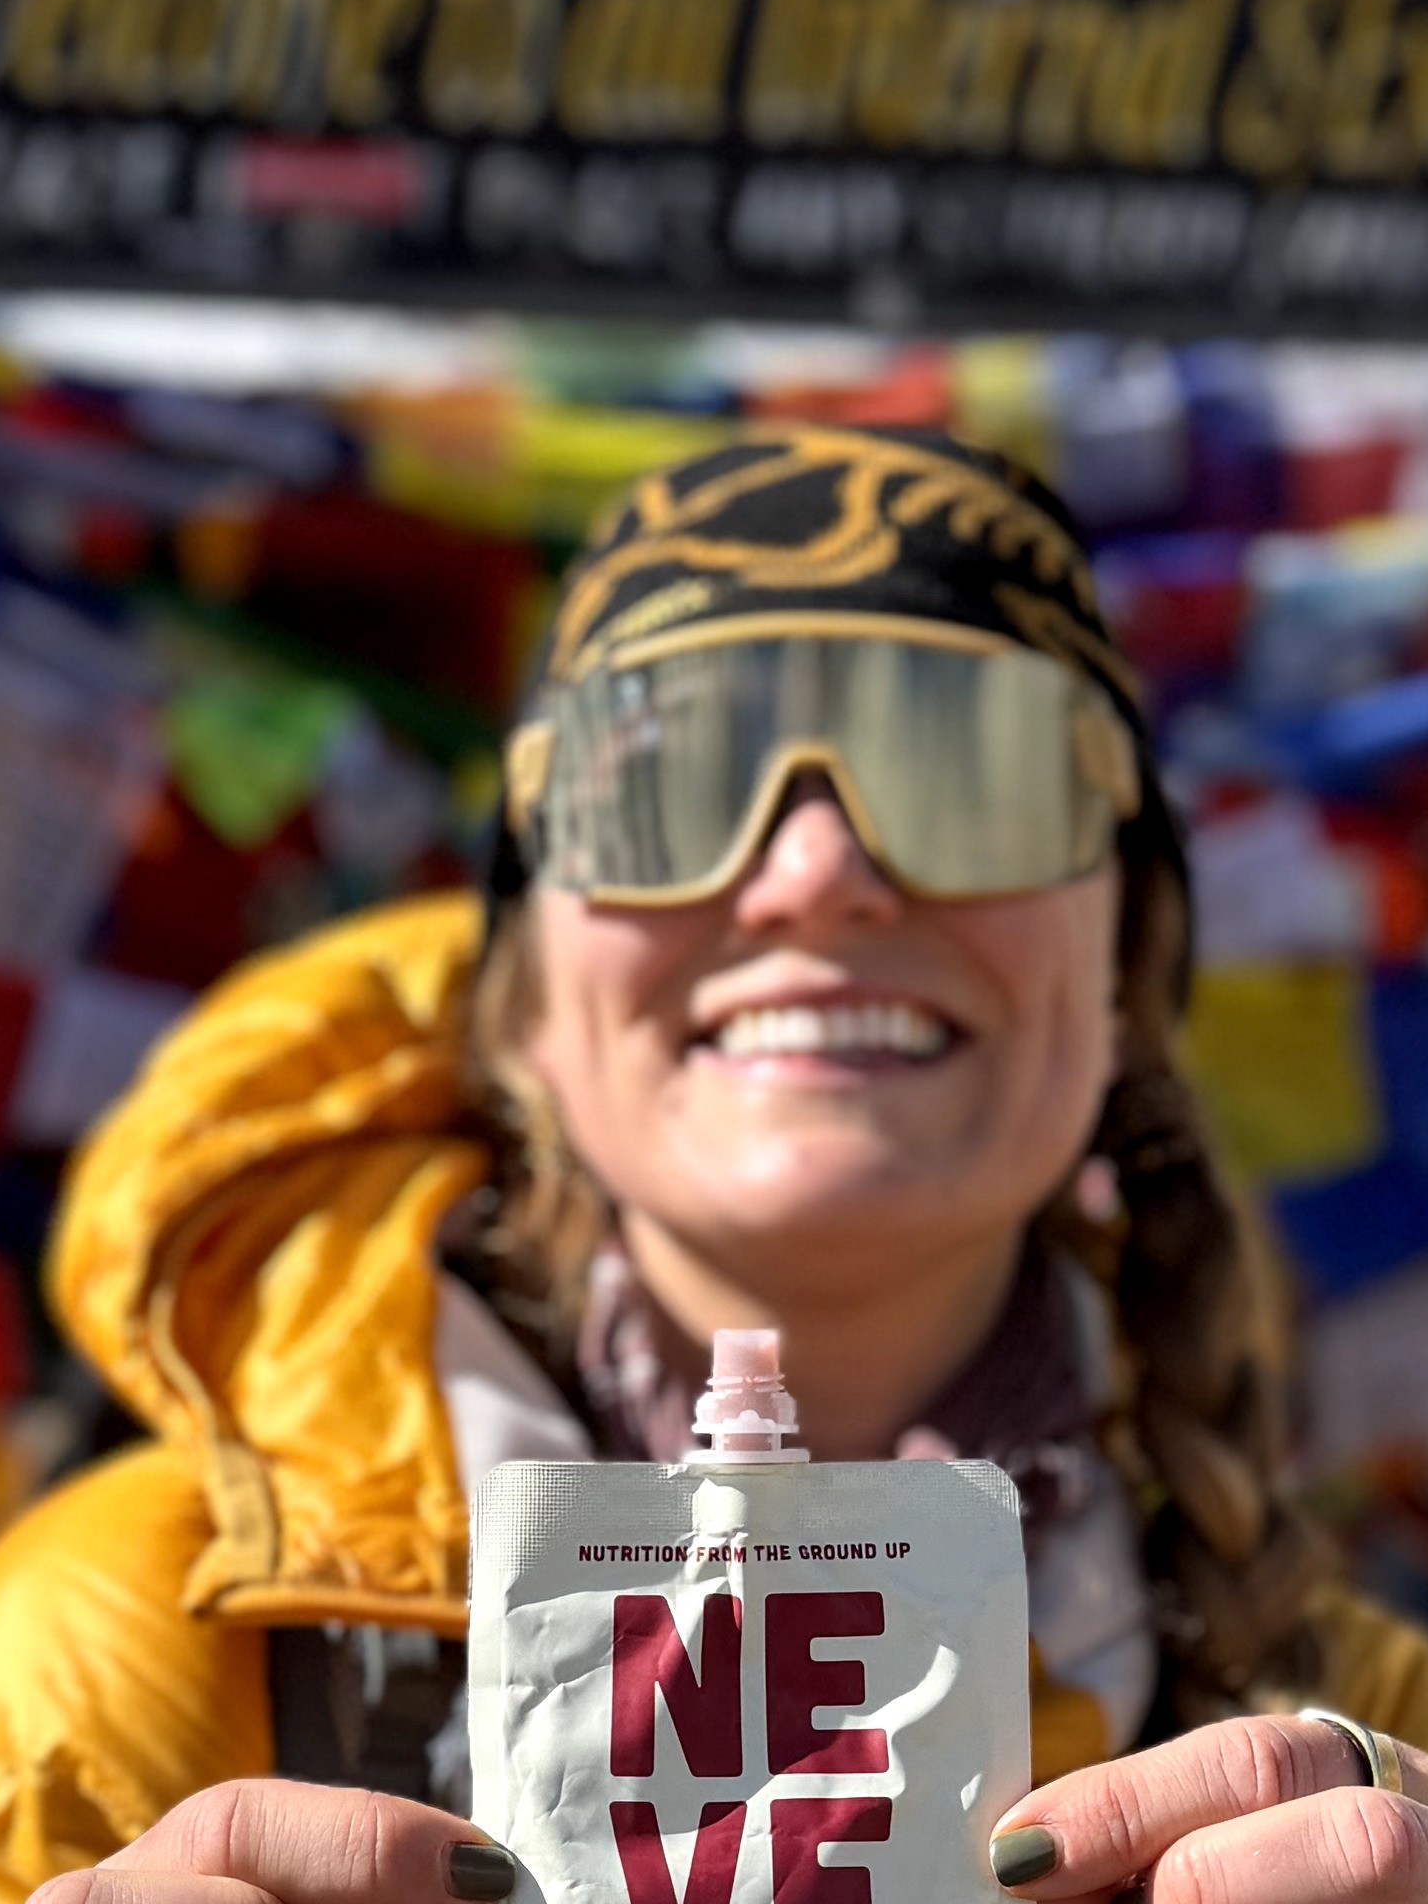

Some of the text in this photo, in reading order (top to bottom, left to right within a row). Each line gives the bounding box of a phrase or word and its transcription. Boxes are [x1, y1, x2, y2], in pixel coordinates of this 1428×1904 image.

[579, 1541, 911, 1564] NUTRITION FROM THE GROUND UP
[609, 1590, 889, 1778] NE
